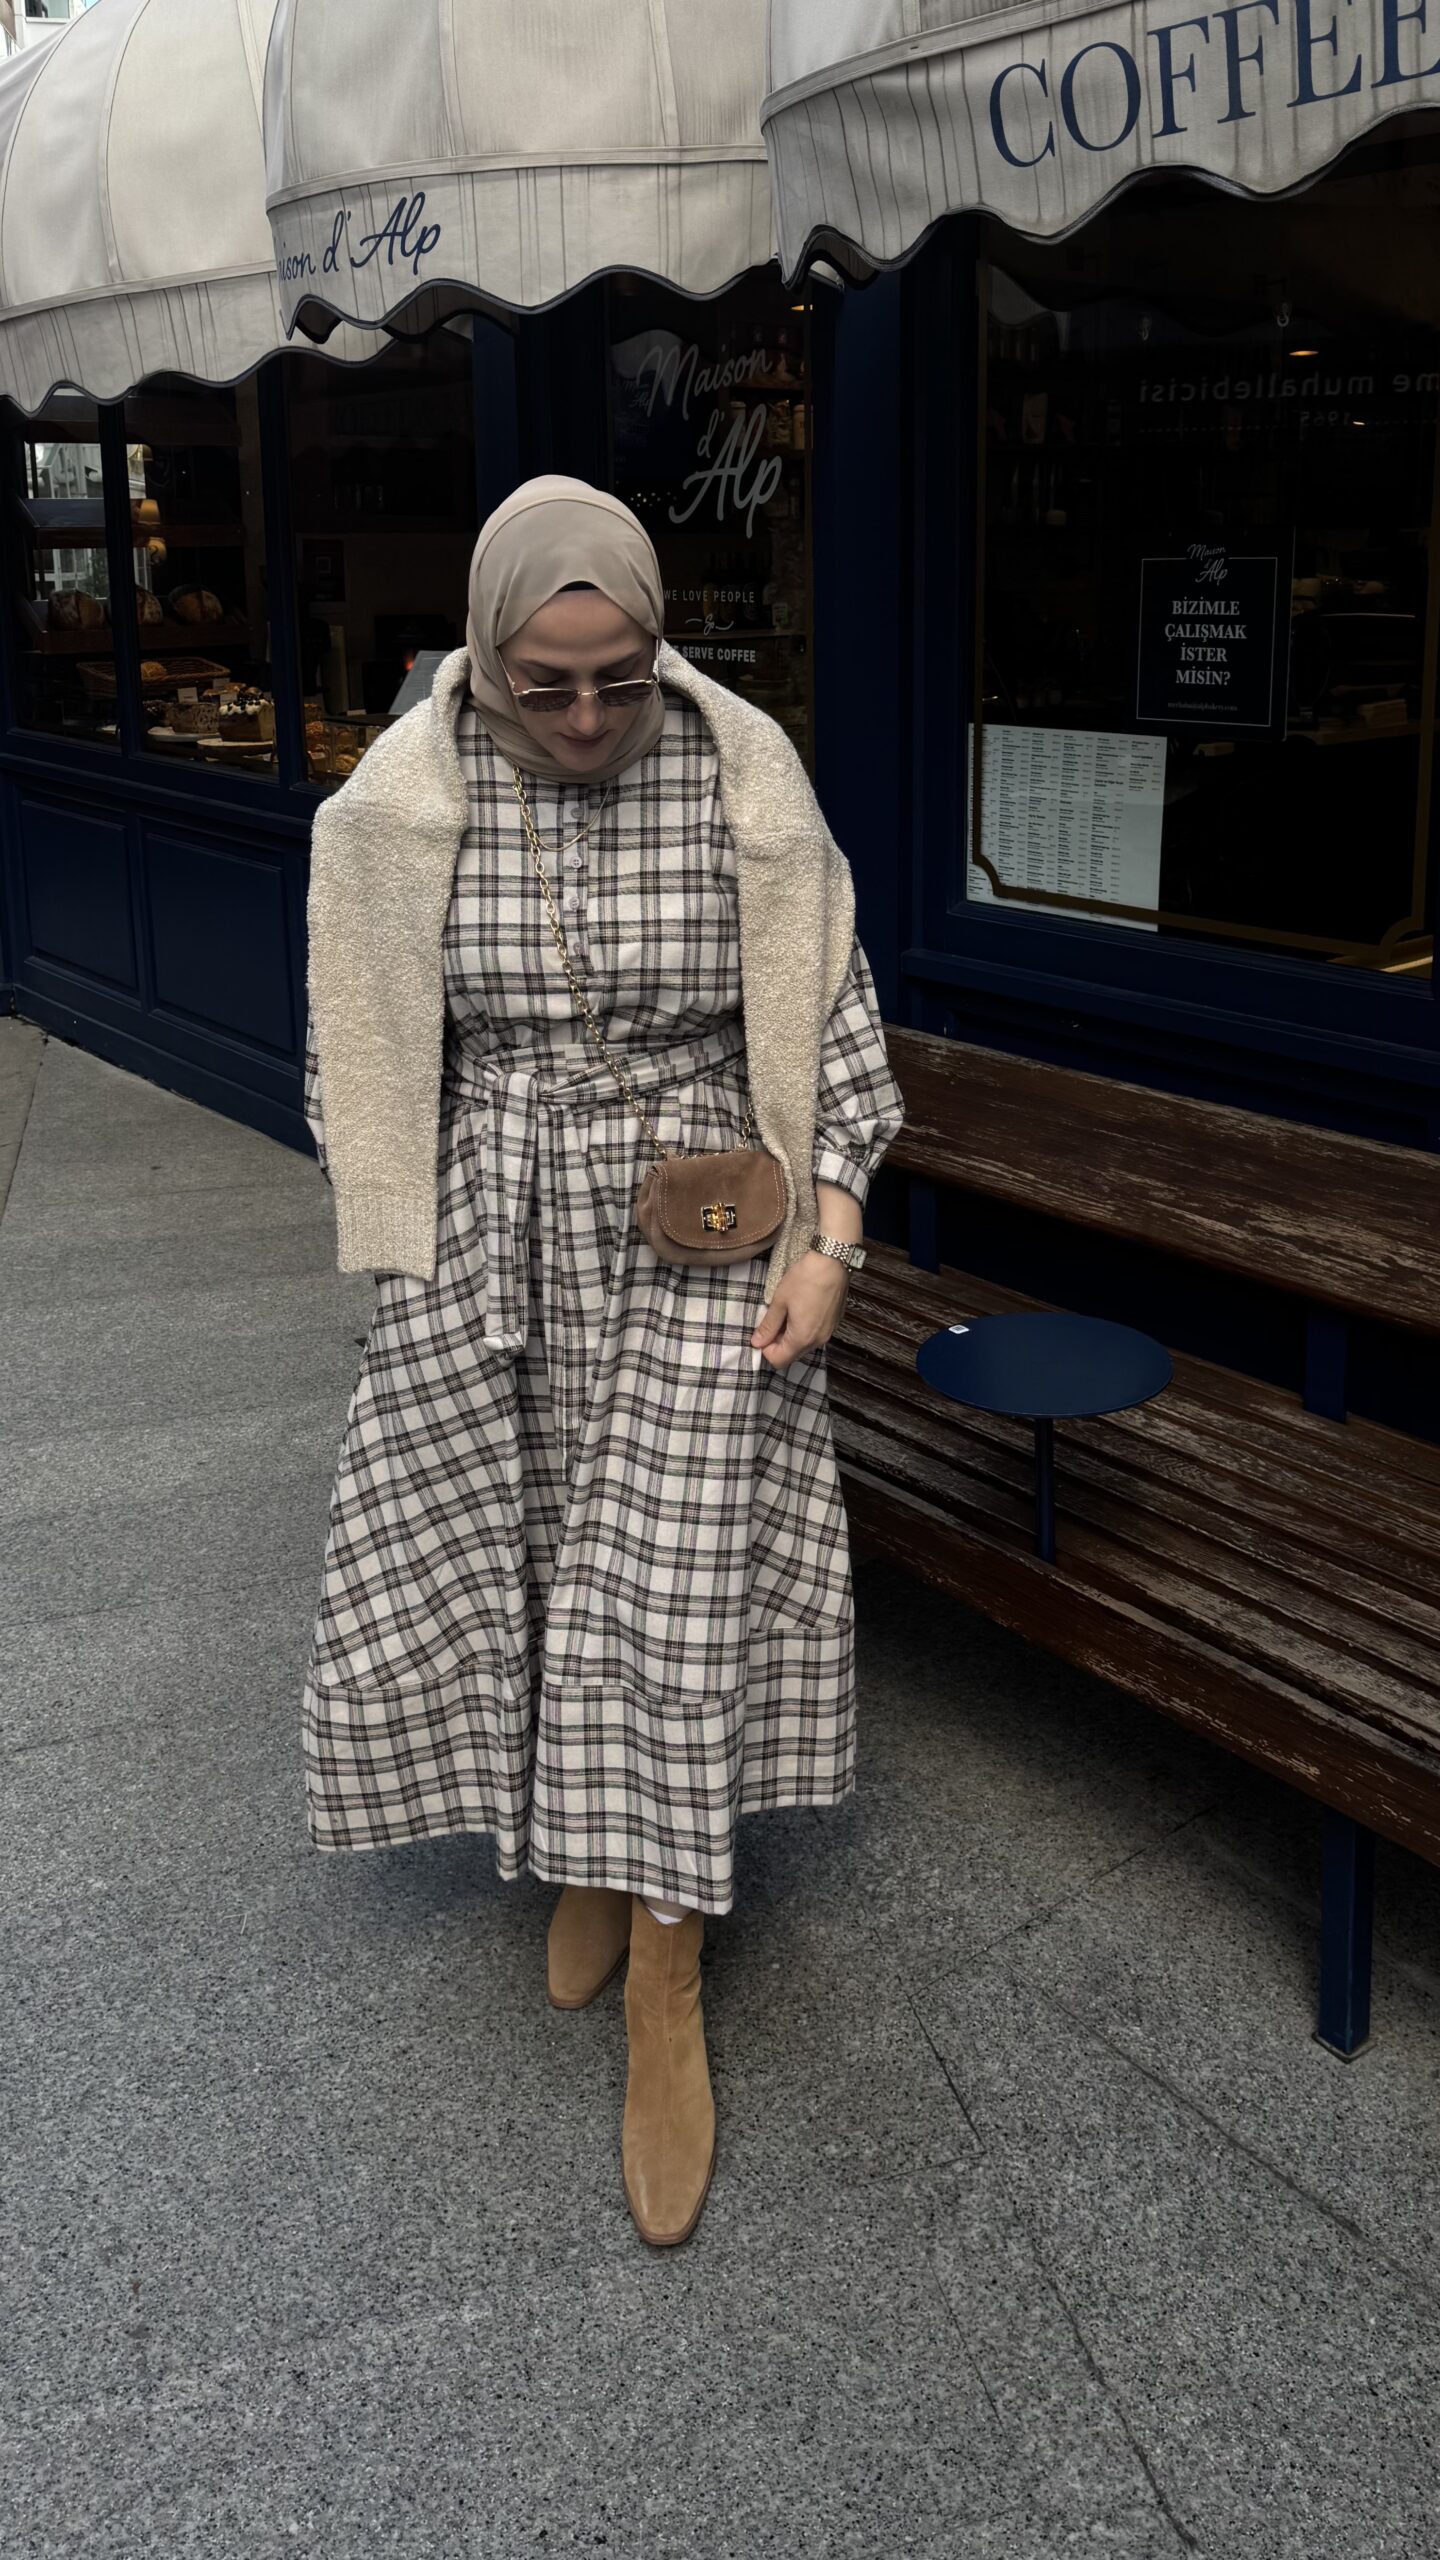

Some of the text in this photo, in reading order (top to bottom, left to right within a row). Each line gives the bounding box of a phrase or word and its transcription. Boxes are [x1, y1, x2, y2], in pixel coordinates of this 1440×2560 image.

[990, 0, 1440, 168] COFFEE
[636, 344, 773, 422] Maison
[668, 403, 783, 539] Alp
[1195, 557, 1229, 586] Alp
[663, 588, 755, 603] WE LOVE PEOPLE
[1171, 595, 1240, 616] BİZİMLE
[1164, 623, 1248, 642] ÇALIŞMAK
[682, 645, 714, 660] SERVE
[717, 647, 757, 663] COFFEE
[1180, 642, 1228, 663] İSTER
[1175, 665, 1232, 686] MİSİN?
